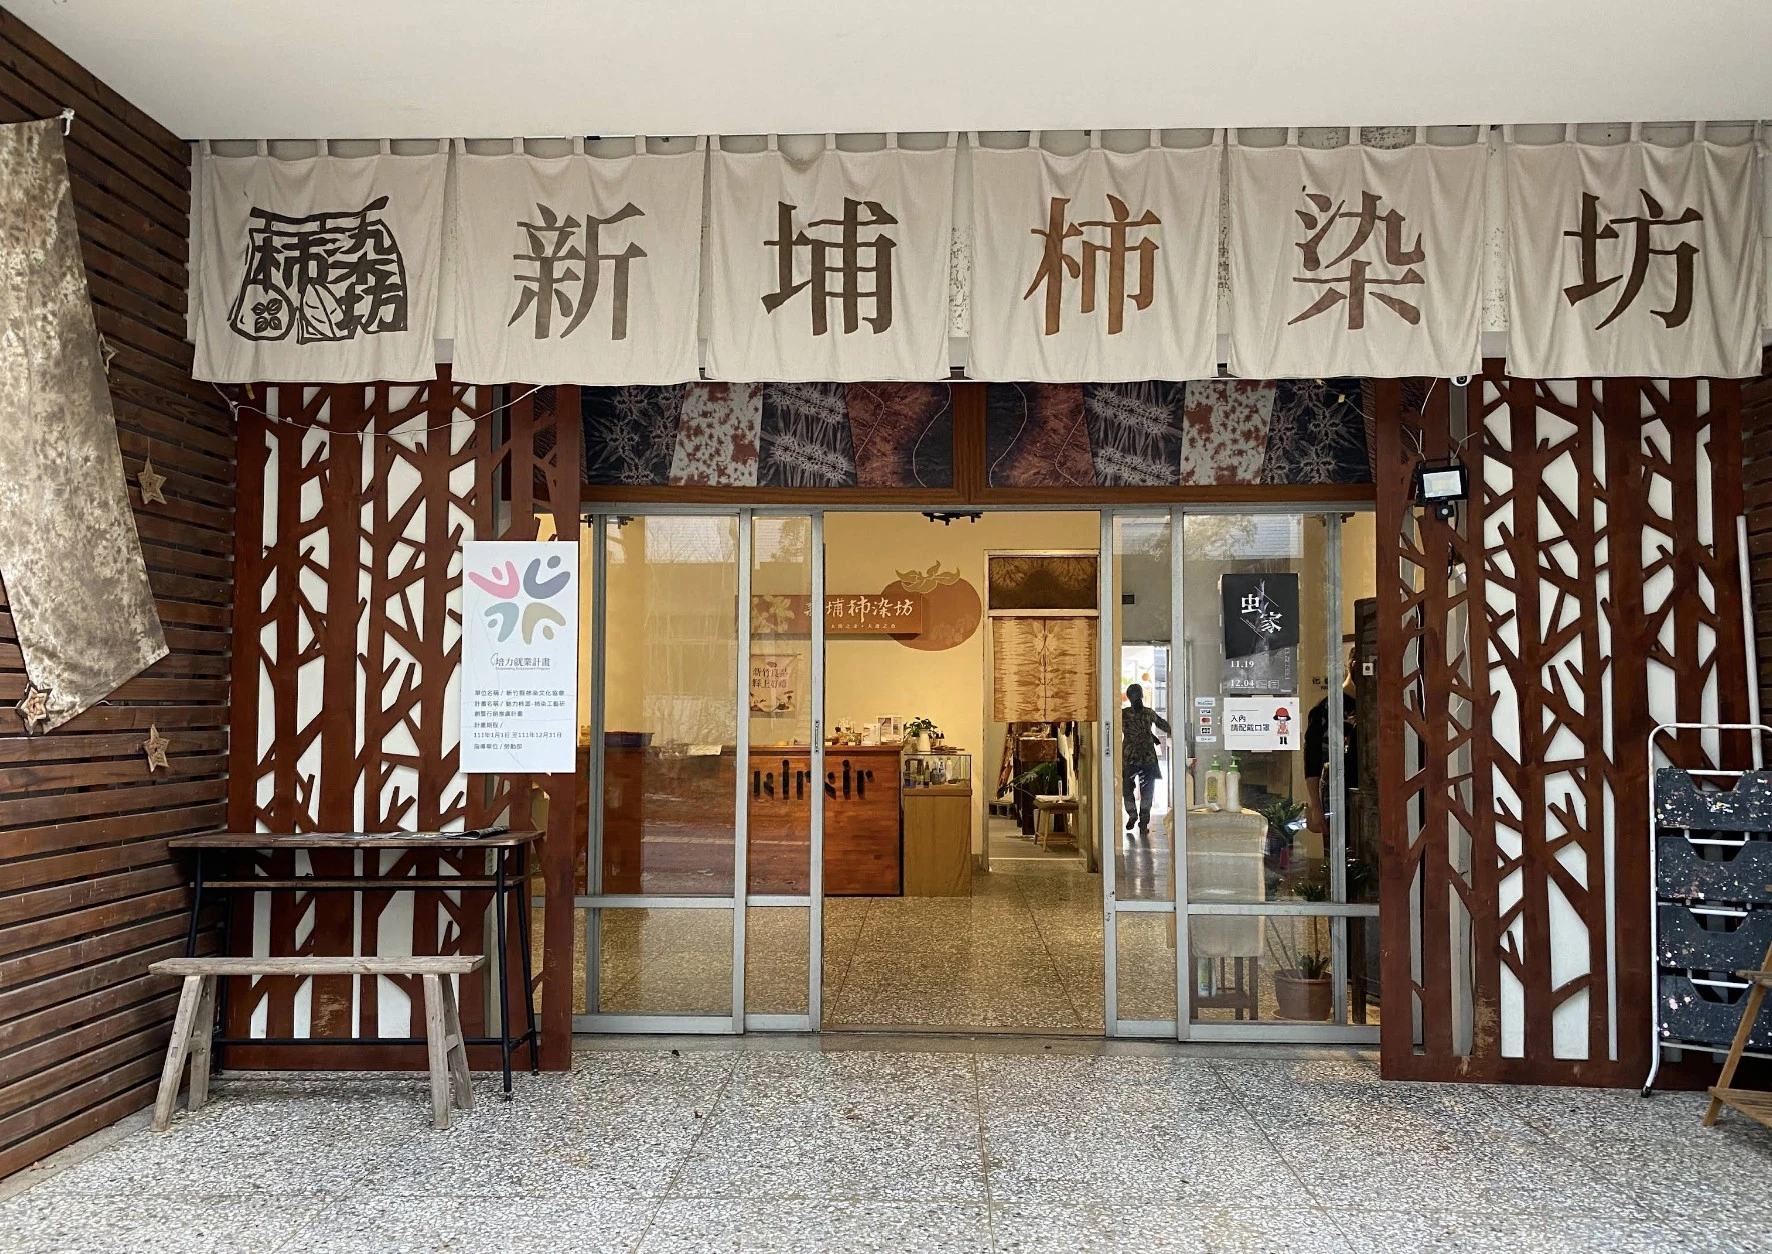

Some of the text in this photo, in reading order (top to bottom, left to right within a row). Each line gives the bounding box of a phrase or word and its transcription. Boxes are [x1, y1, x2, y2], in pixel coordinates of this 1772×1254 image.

[507, 188, 1705, 341] 新埔柿染坊
[495, 657, 551, 667] 培力就業計畫
[1230, 660, 1255, 668] 11.19
[1230, 679, 1255, 687] 12.04
[1230, 714, 1246, 723] 入內
[1230, 723, 1270, 732] 請配戴口罩
